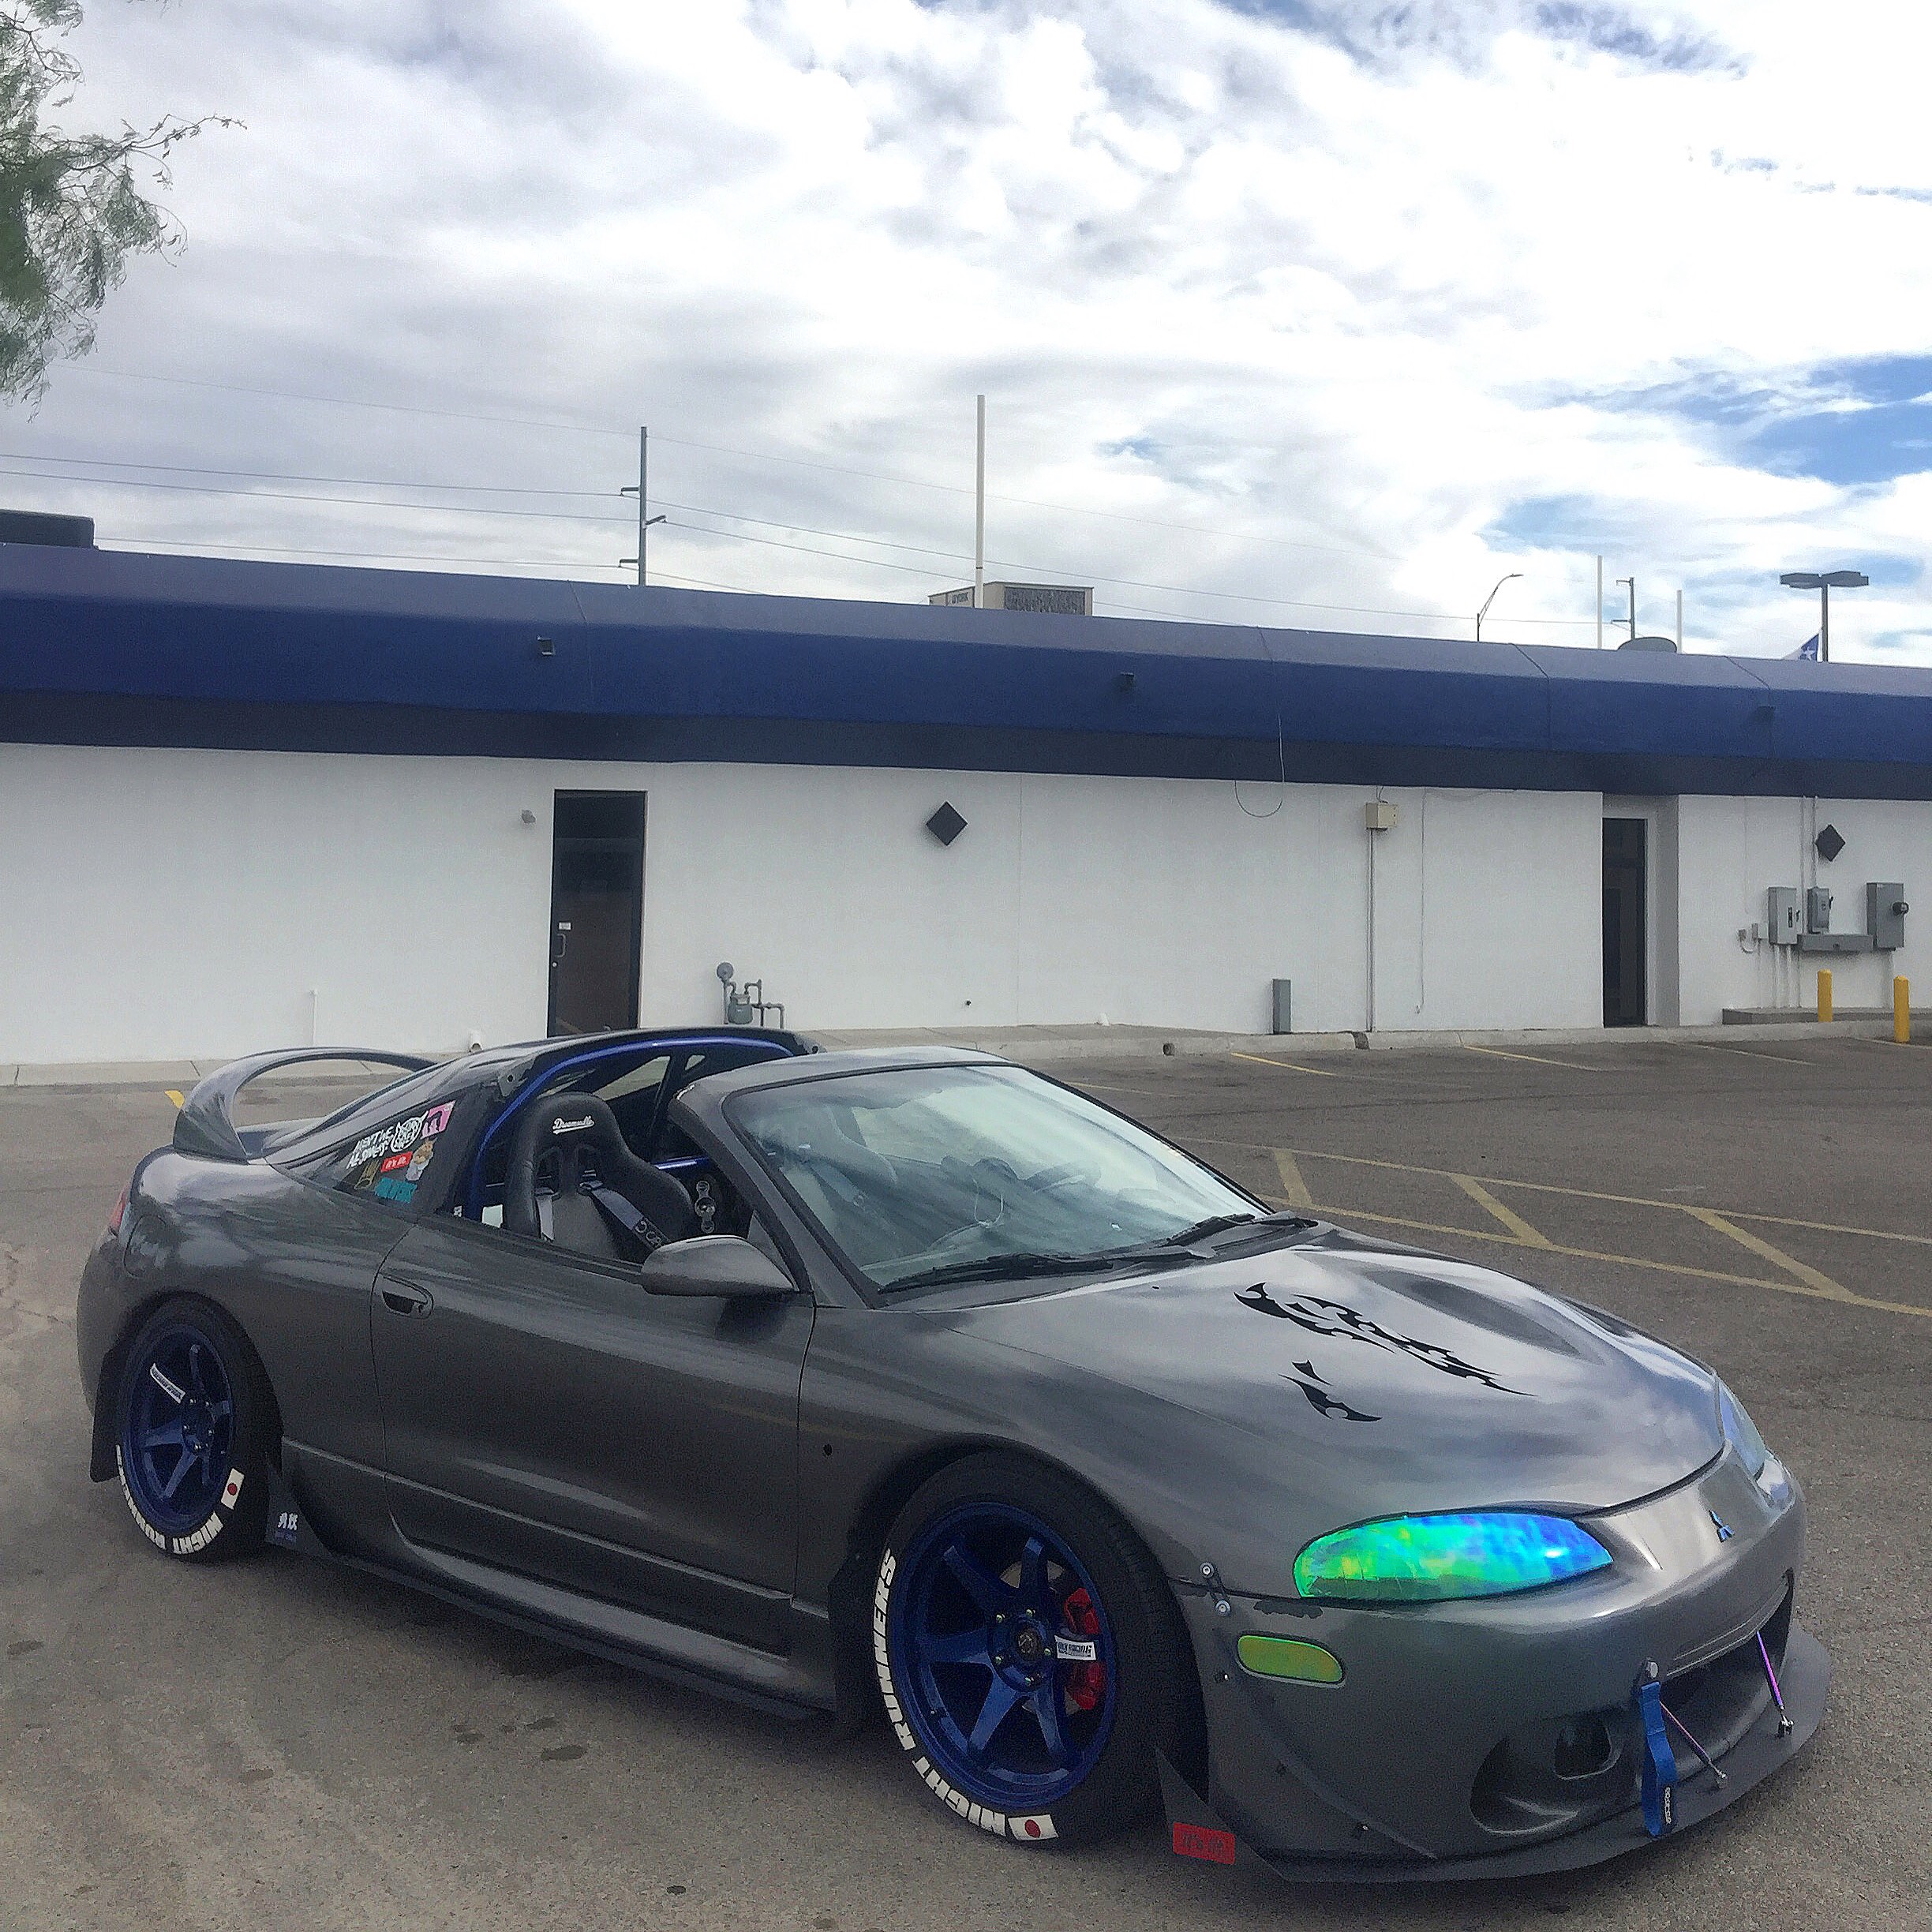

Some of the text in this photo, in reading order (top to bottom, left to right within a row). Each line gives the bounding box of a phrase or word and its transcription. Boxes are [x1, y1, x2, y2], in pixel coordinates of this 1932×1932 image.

[172, 1511, 223, 1555] NIGHT
[873, 1548, 1006, 1836] NIGHT RUNNERS
